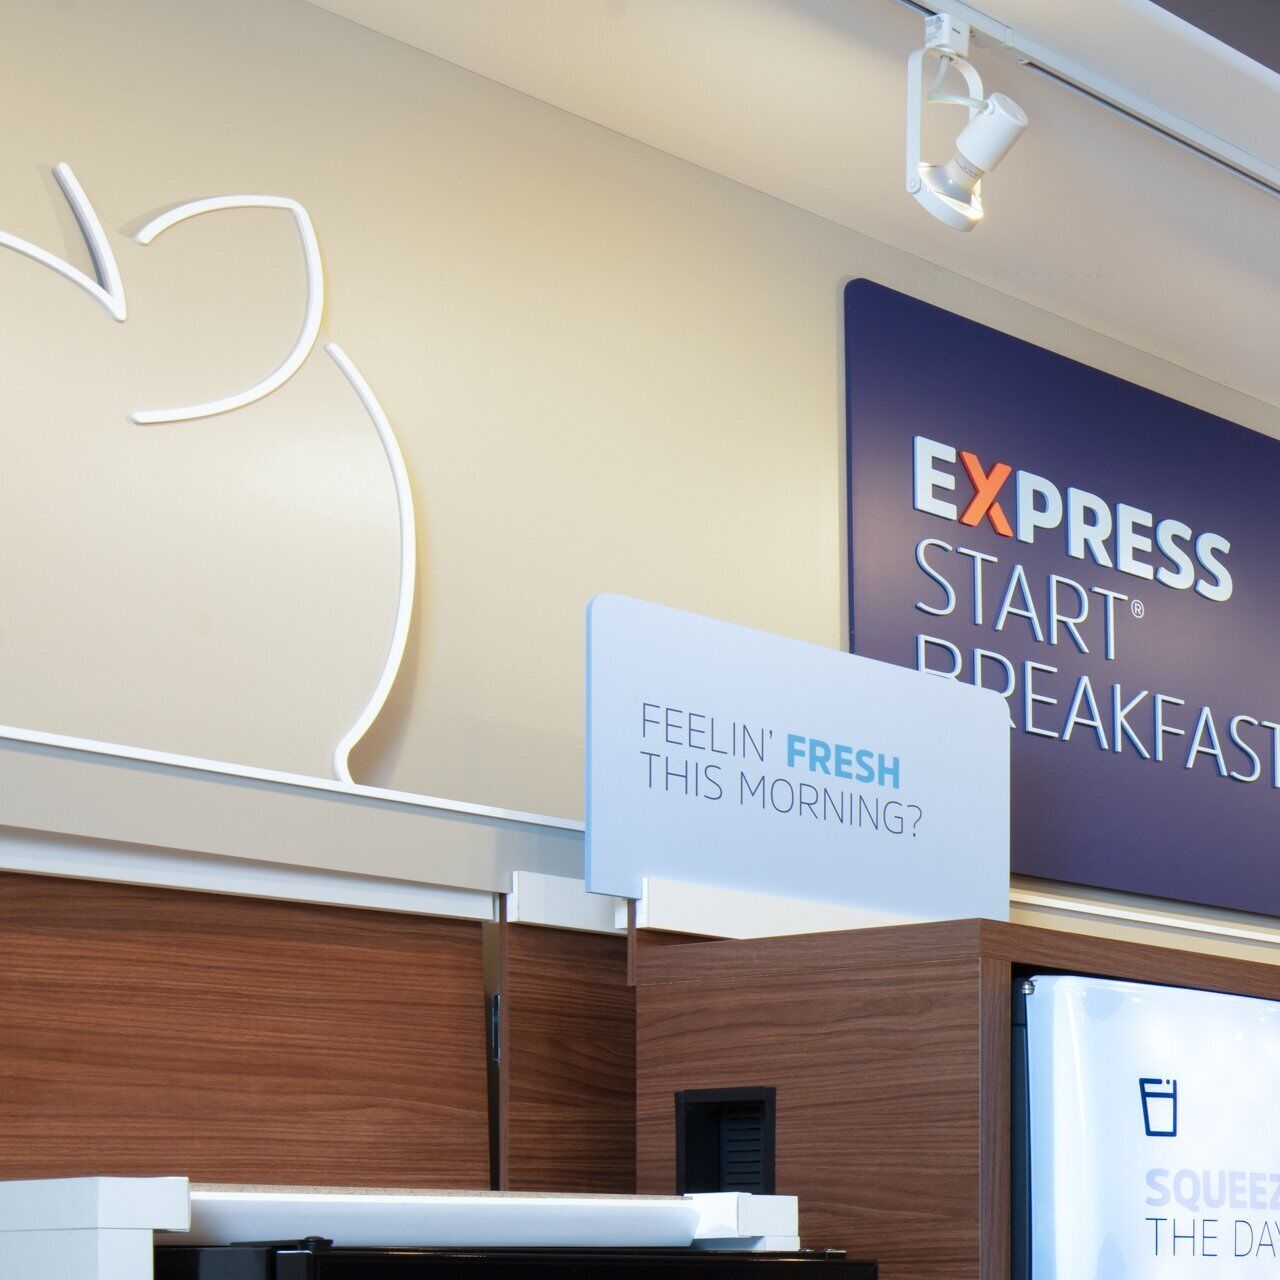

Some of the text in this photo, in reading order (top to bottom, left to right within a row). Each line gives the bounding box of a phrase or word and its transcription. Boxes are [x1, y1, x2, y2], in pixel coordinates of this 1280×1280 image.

[913, 435, 1234, 602] EXPRESS
[640, 750, 923, 838] THIS MORNING?
[787, 733, 900, 789] FRESH
[1145, 1217, 1218, 1257] THE
